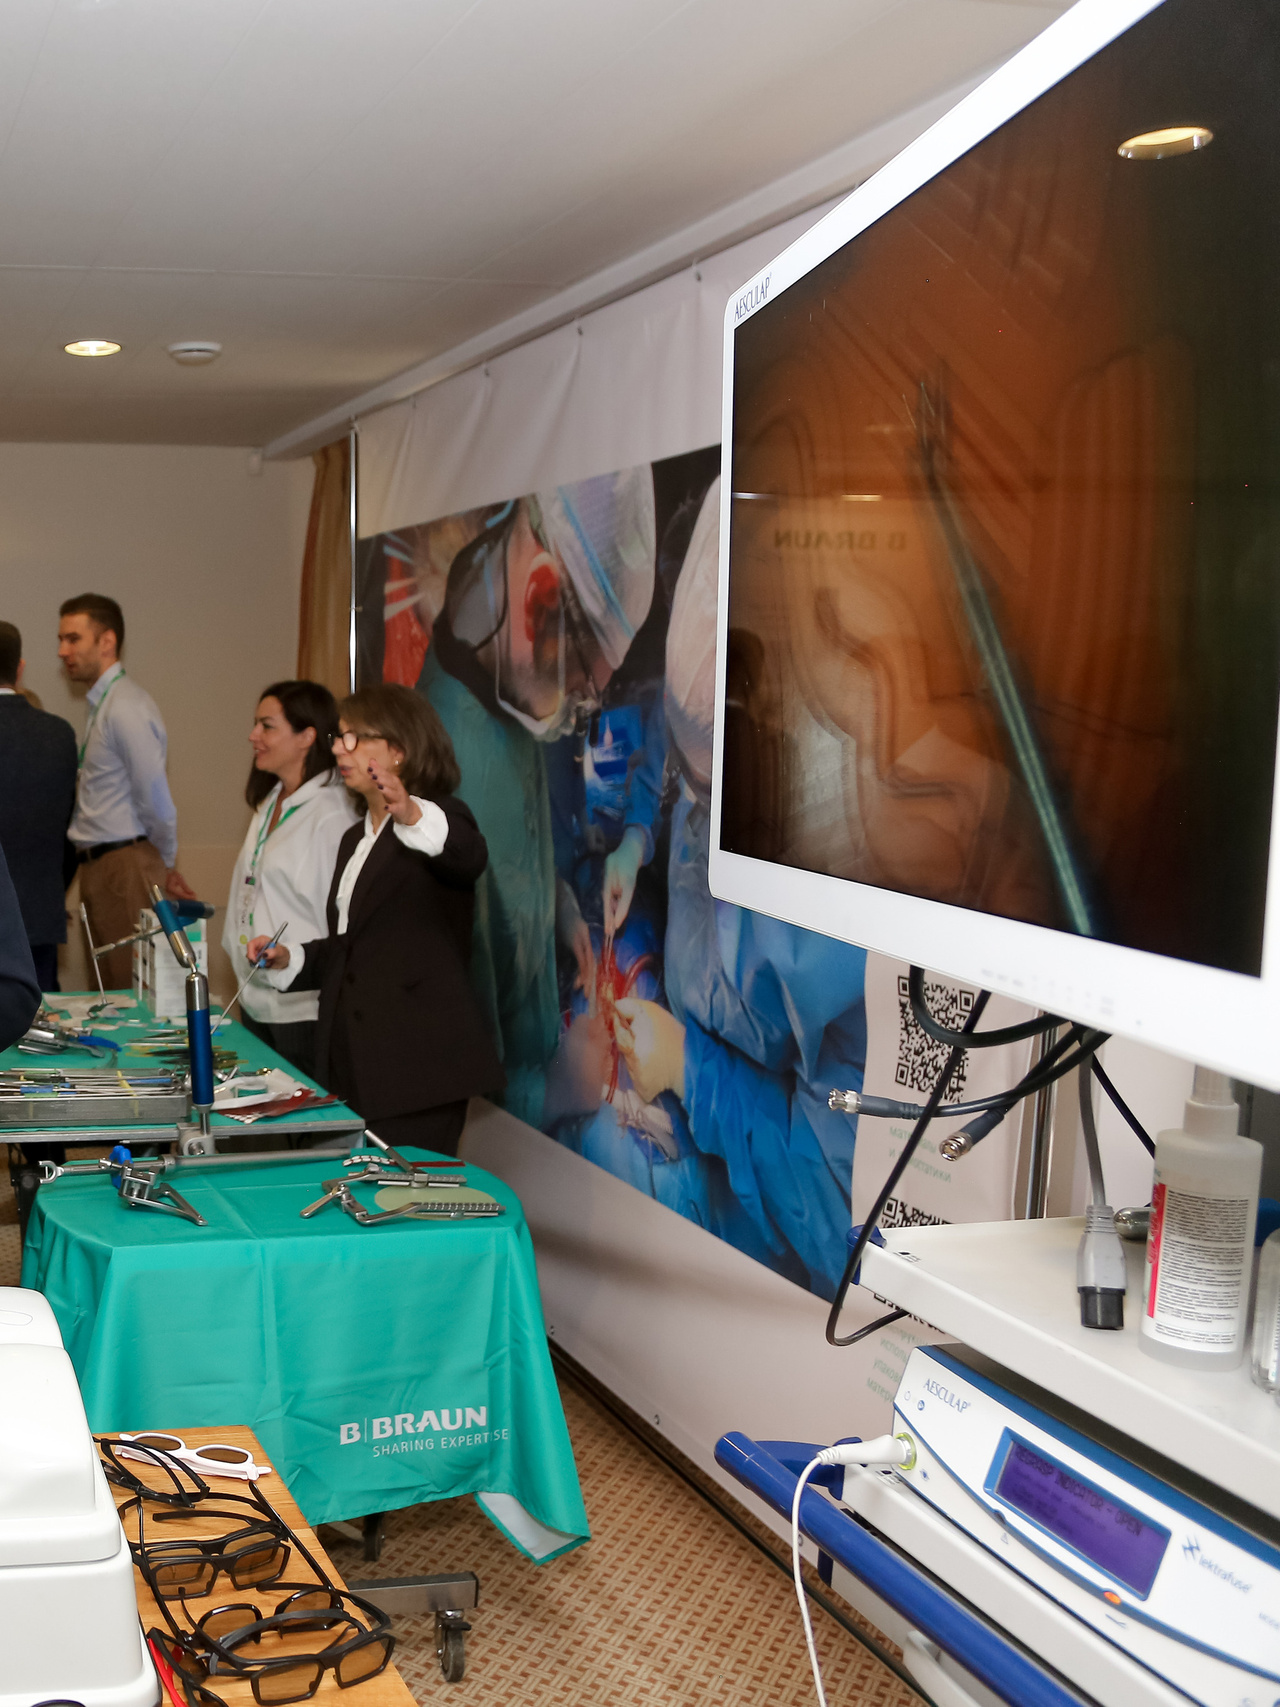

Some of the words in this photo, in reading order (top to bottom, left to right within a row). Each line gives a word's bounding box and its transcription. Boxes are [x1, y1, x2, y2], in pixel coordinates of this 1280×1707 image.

[734, 276, 770, 323] AESCULAP
[923, 1378, 968, 1413] AESCULAP
[372, 1406, 487, 1440] BRAUN
[372, 1438, 435, 1458] SHARING
